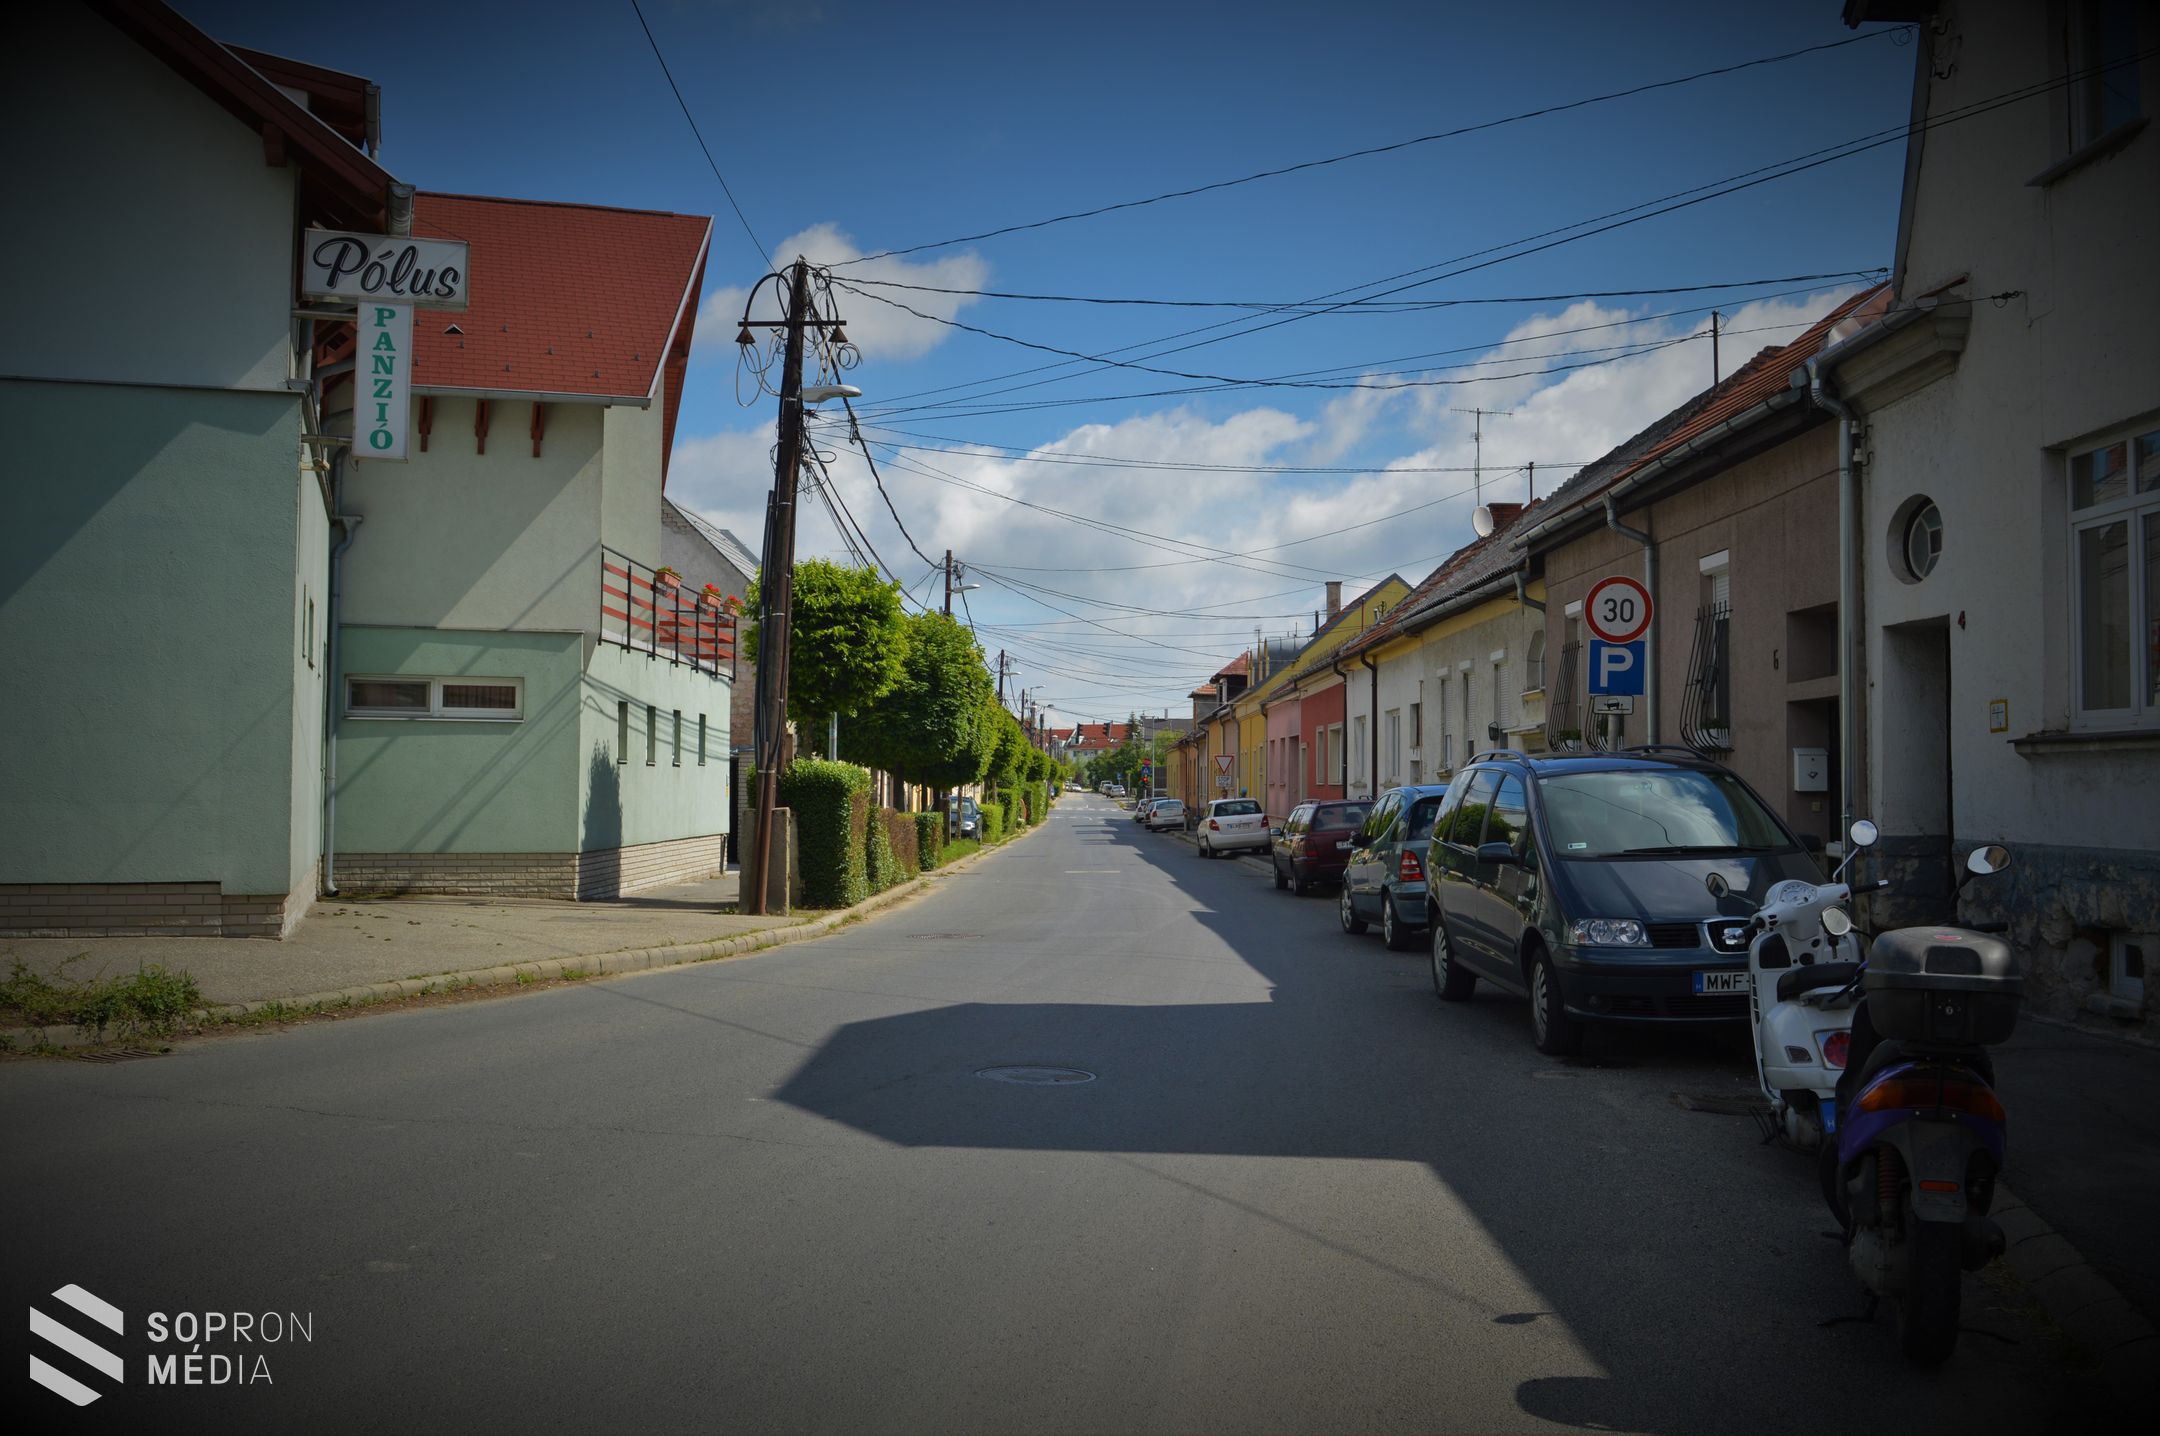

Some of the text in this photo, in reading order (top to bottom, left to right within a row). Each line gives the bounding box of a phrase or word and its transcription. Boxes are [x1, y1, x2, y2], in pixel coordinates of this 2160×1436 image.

[313, 237, 460, 298] Pólus
[369, 307, 397, 450] PANZIÓ
[1604, 598, 1635, 623] 30
[1958, 610, 1966, 631] 4
[1599, 646, 1635, 688] P
[1773, 648, 1780, 672] 6
